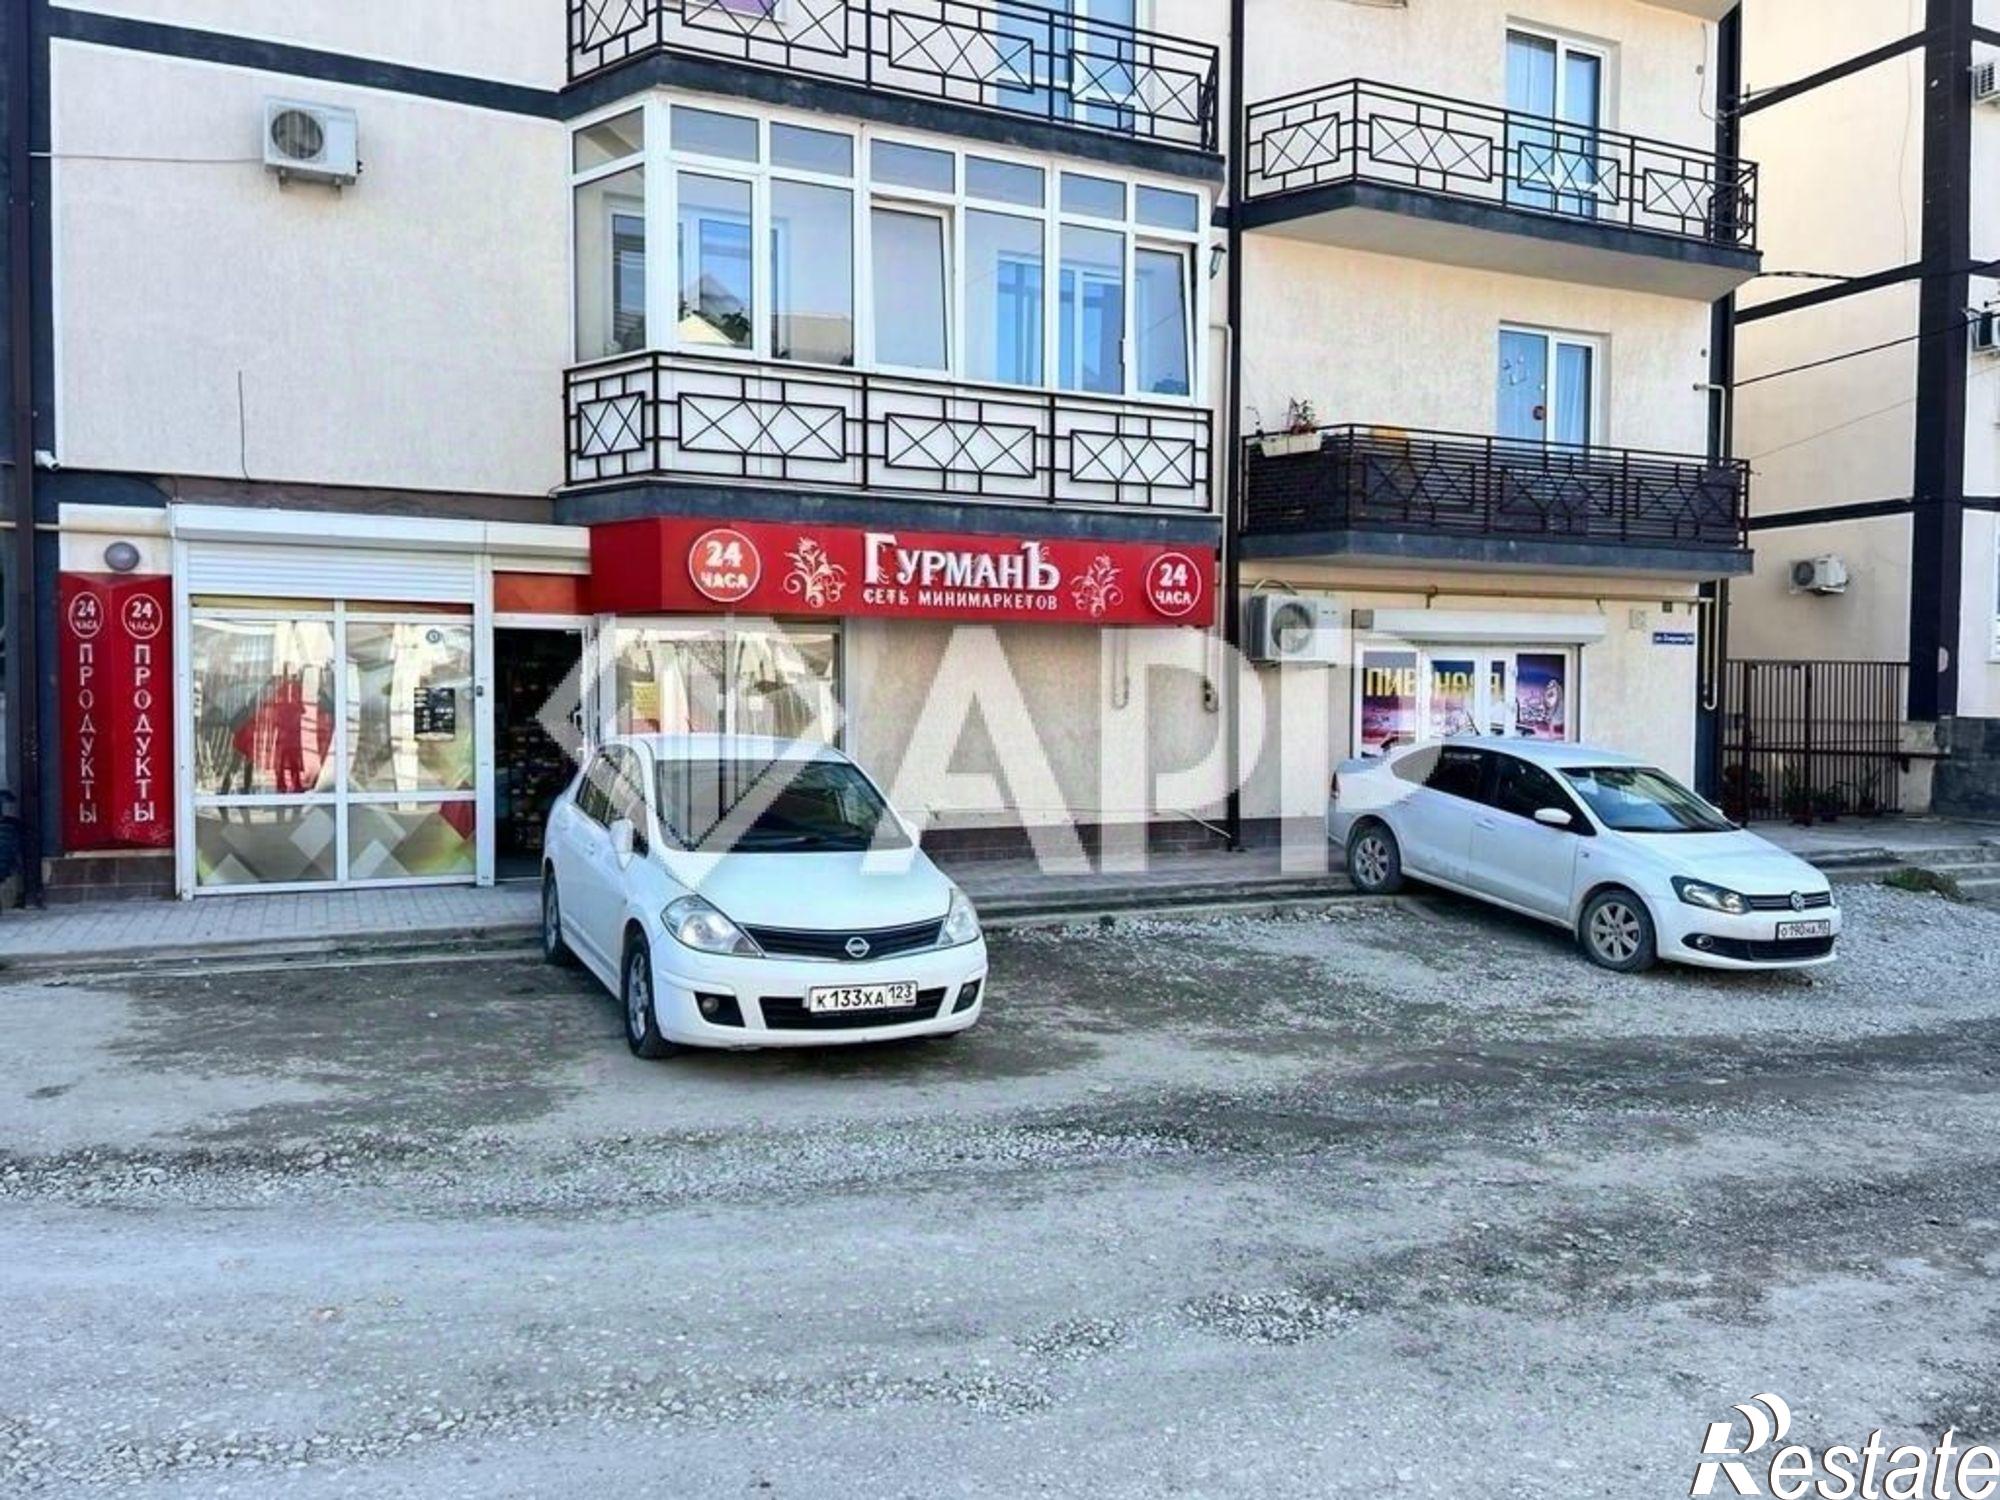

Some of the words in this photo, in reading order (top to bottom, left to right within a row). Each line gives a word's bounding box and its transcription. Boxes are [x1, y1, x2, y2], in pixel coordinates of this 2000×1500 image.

[705, 540, 743, 568] 24
[700, 571, 749, 589] ЧАСА
[1160, 563, 1188, 587] 24
[863, 589, 909, 606] СЕТЬ
[918, 591, 1058, 610] МИНИМАРКЕТОВ
[1155, 590, 1192, 605] ЧАСА
[77, 600, 95, 617] 24
[131, 601, 153, 618] 24
[74, 618, 99, 631] ЧАСА
[128, 619, 155, 632] ЧАСА
[78, 643, 97, 824] ПРОДУКТЫ
[133, 644, 155, 822] ПРОДУКТЫ
[816, 989, 884, 1008] К133ХА
[888, 984, 912, 999] 123
